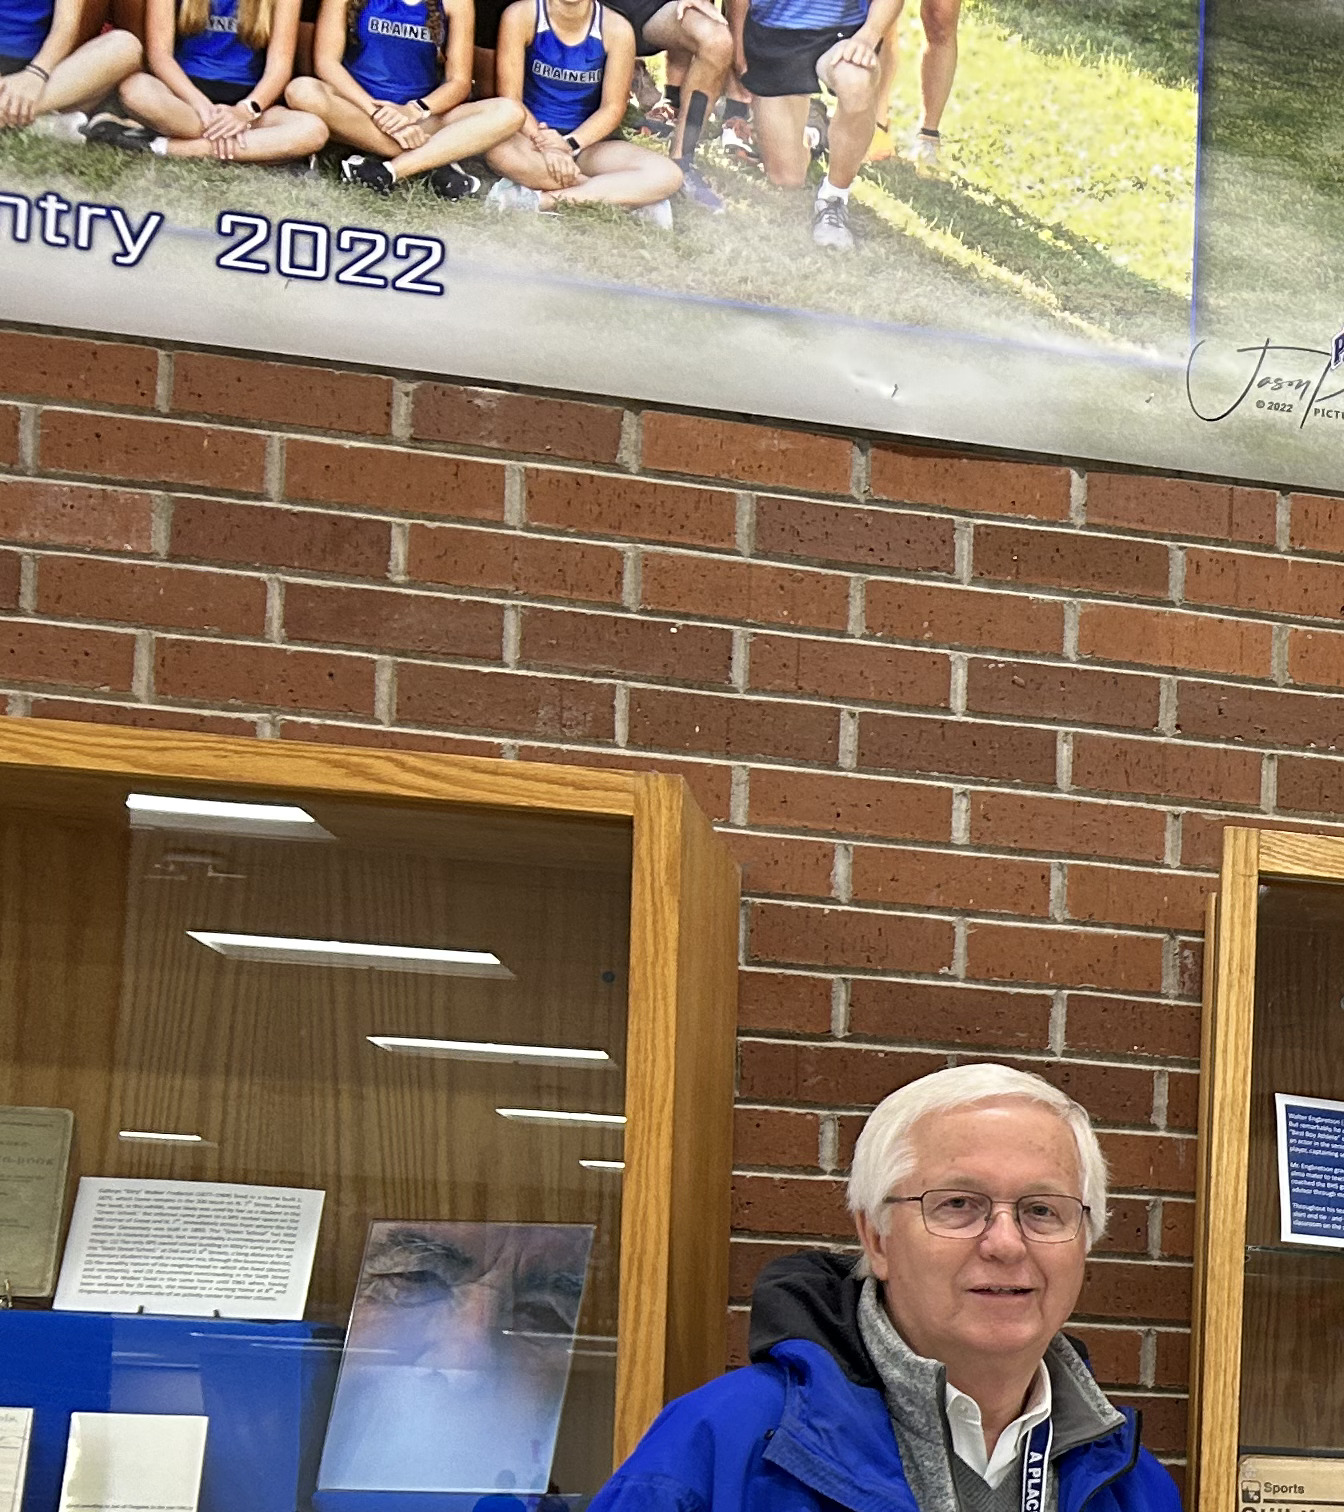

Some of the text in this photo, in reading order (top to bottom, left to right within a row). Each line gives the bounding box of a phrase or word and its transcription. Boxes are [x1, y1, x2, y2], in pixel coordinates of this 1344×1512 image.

[368, 17, 434, 43] BRAINE
[0, 191, 447, 297] ntry 2022
[1267, 401, 1294, 413] 2022
[1028, 1451, 1043, 1464] A
[1263, 1482, 1305, 1494] Sports
